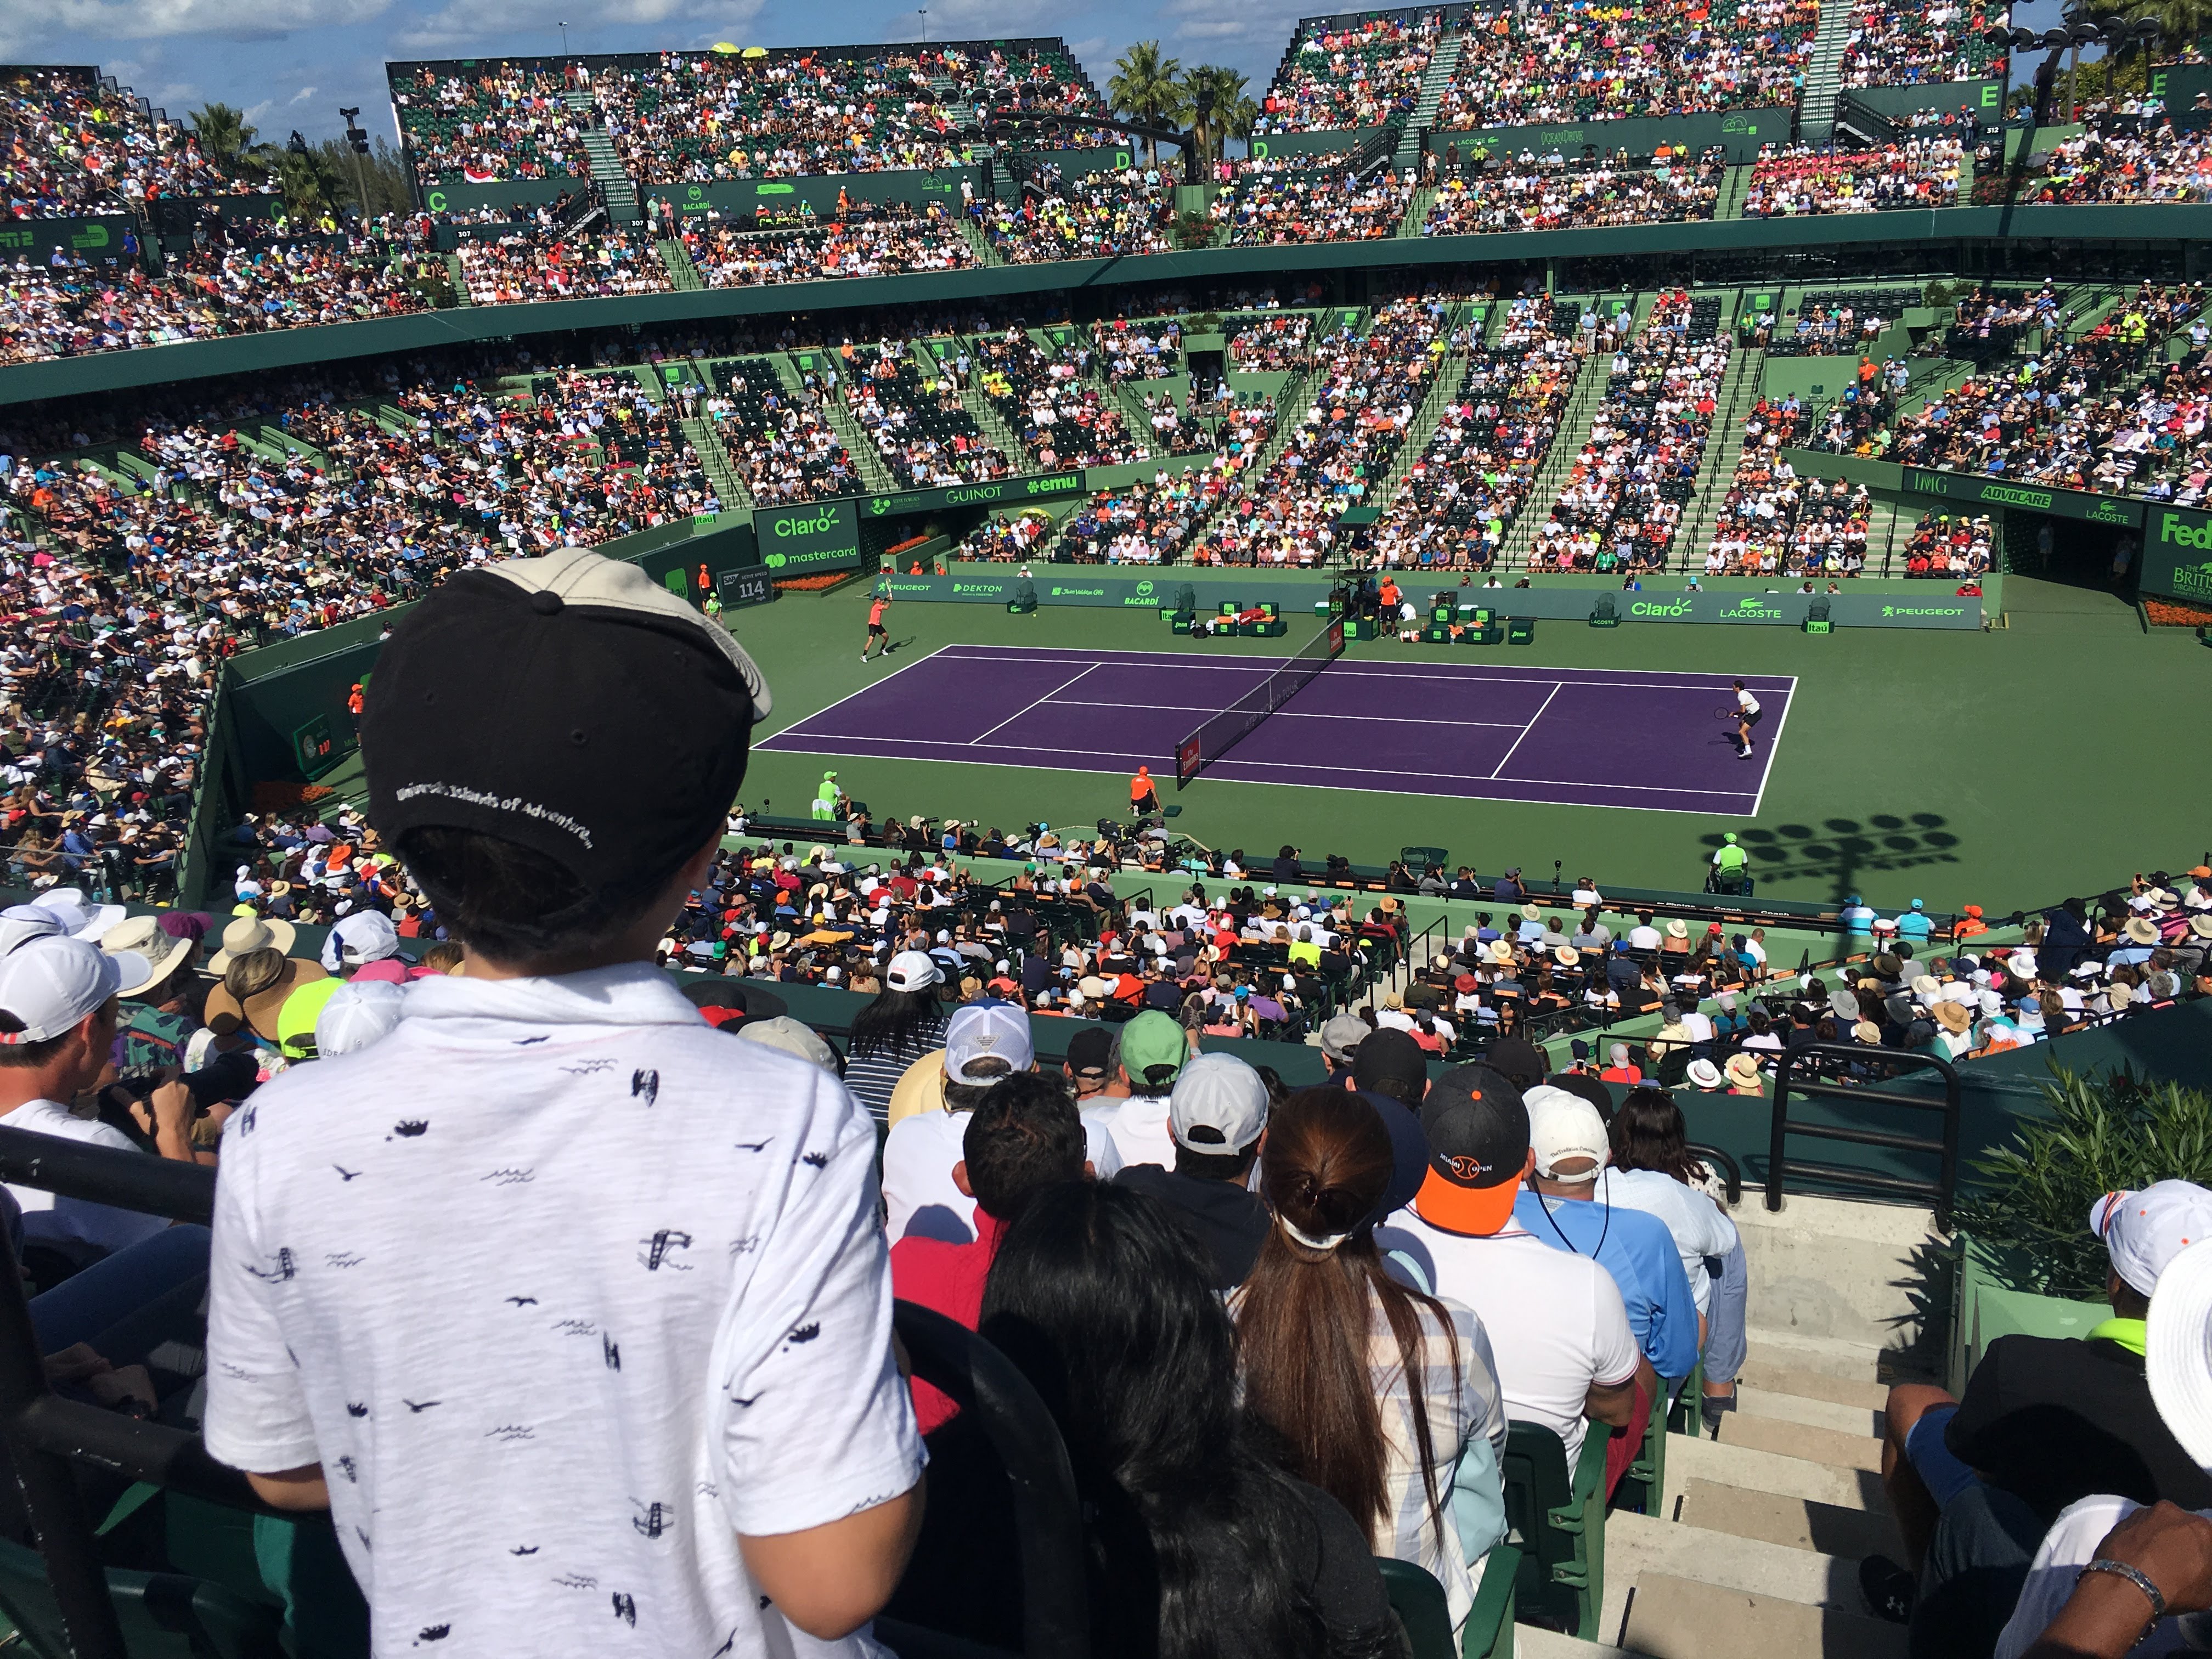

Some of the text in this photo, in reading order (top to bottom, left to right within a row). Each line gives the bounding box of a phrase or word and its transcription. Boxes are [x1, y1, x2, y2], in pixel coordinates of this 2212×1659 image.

[2153, 74, 2168, 95] E
[1981, 86, 1999, 107] E
[1254, 142, 1268, 160] D
[1116, 152, 1130, 170] D
[270, 201, 283, 221] C
[430, 192, 447, 212] C
[1040, 476, 1077, 492] emu
[1914, 472, 1948, 494] IMG
[946, 486, 1003, 504] GUINOT
[1980, 486, 2052, 508] ADVOCARE
[696, 516, 713, 524] Itaú
[775, 507, 830, 537] Claro
[2086, 510, 2129, 524] LACOSTE
[789, 545, 857, 563] mastercard
[2186, 565, 2199, 573] THE
[724, 574, 738, 585] SAP
[2172, 583, 2196, 593] VIRGIN
[739, 580, 765, 599] 114
[1631, 597, 1683, 617] Claro
[1720, 609, 1782, 618] LACOSTE
[1809, 624, 1828, 633] Itaú
[501, 797, 522, 811] of
[1440, 1153, 1492, 1173] MIAMI OPEN
